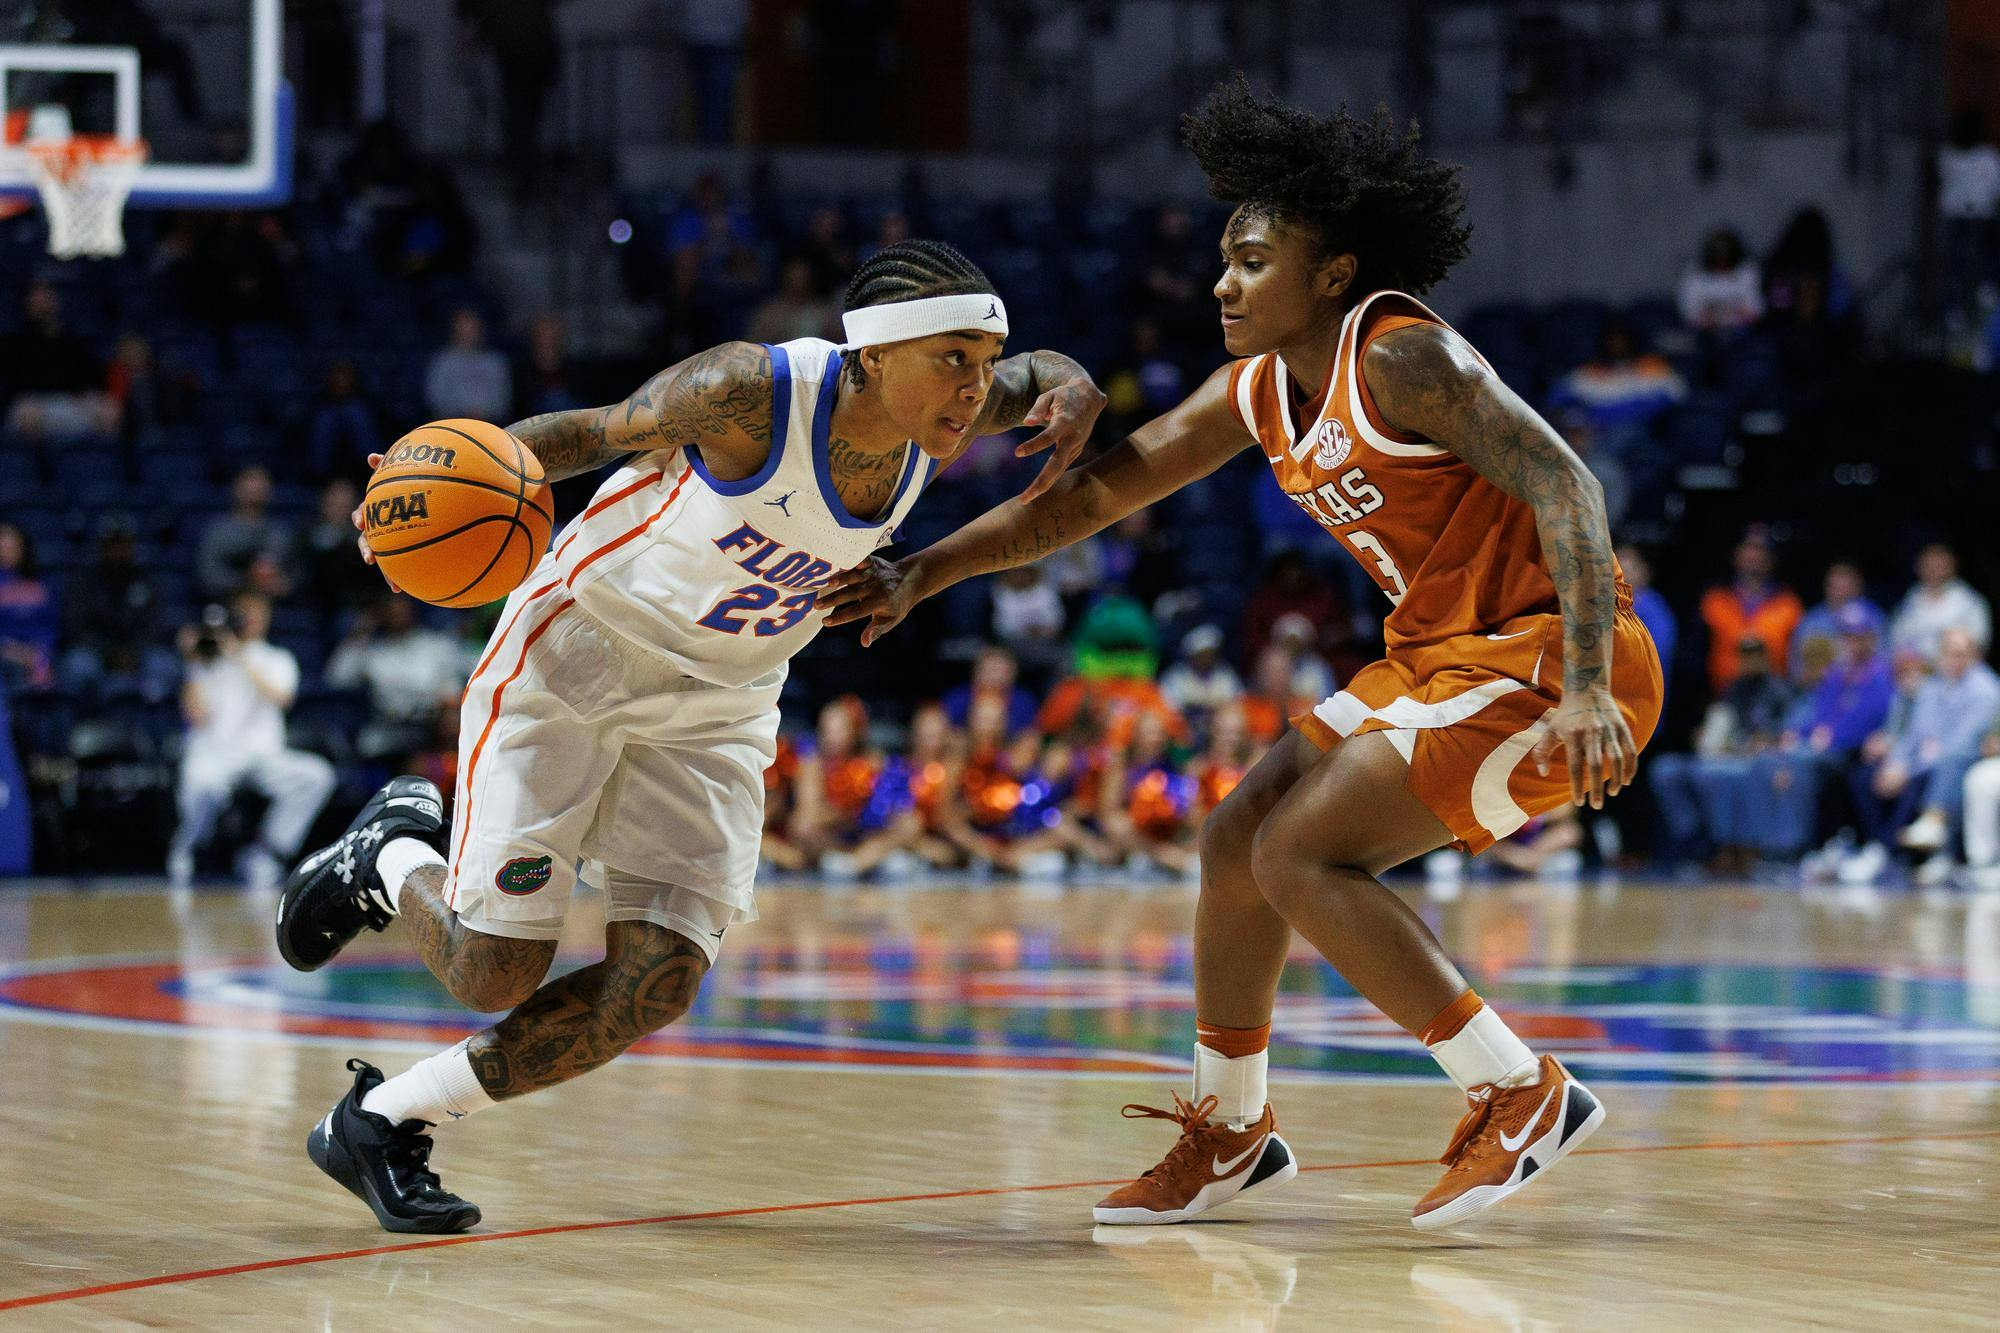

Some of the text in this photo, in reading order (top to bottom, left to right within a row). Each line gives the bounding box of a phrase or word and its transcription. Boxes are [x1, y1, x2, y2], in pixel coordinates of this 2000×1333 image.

[382, 439, 456, 469] lson
[1318, 420, 1344, 457] SEC
[1318, 448, 1349, 469] GRADUATE
[366, 492, 429, 532] NCAA
[1284, 467, 1384, 528] XAS
[407, 522, 431, 530] BALL
[711, 520, 833, 589] FLOR
[1346, 530, 1409, 609] 3
[695, 583, 819, 638] 23
